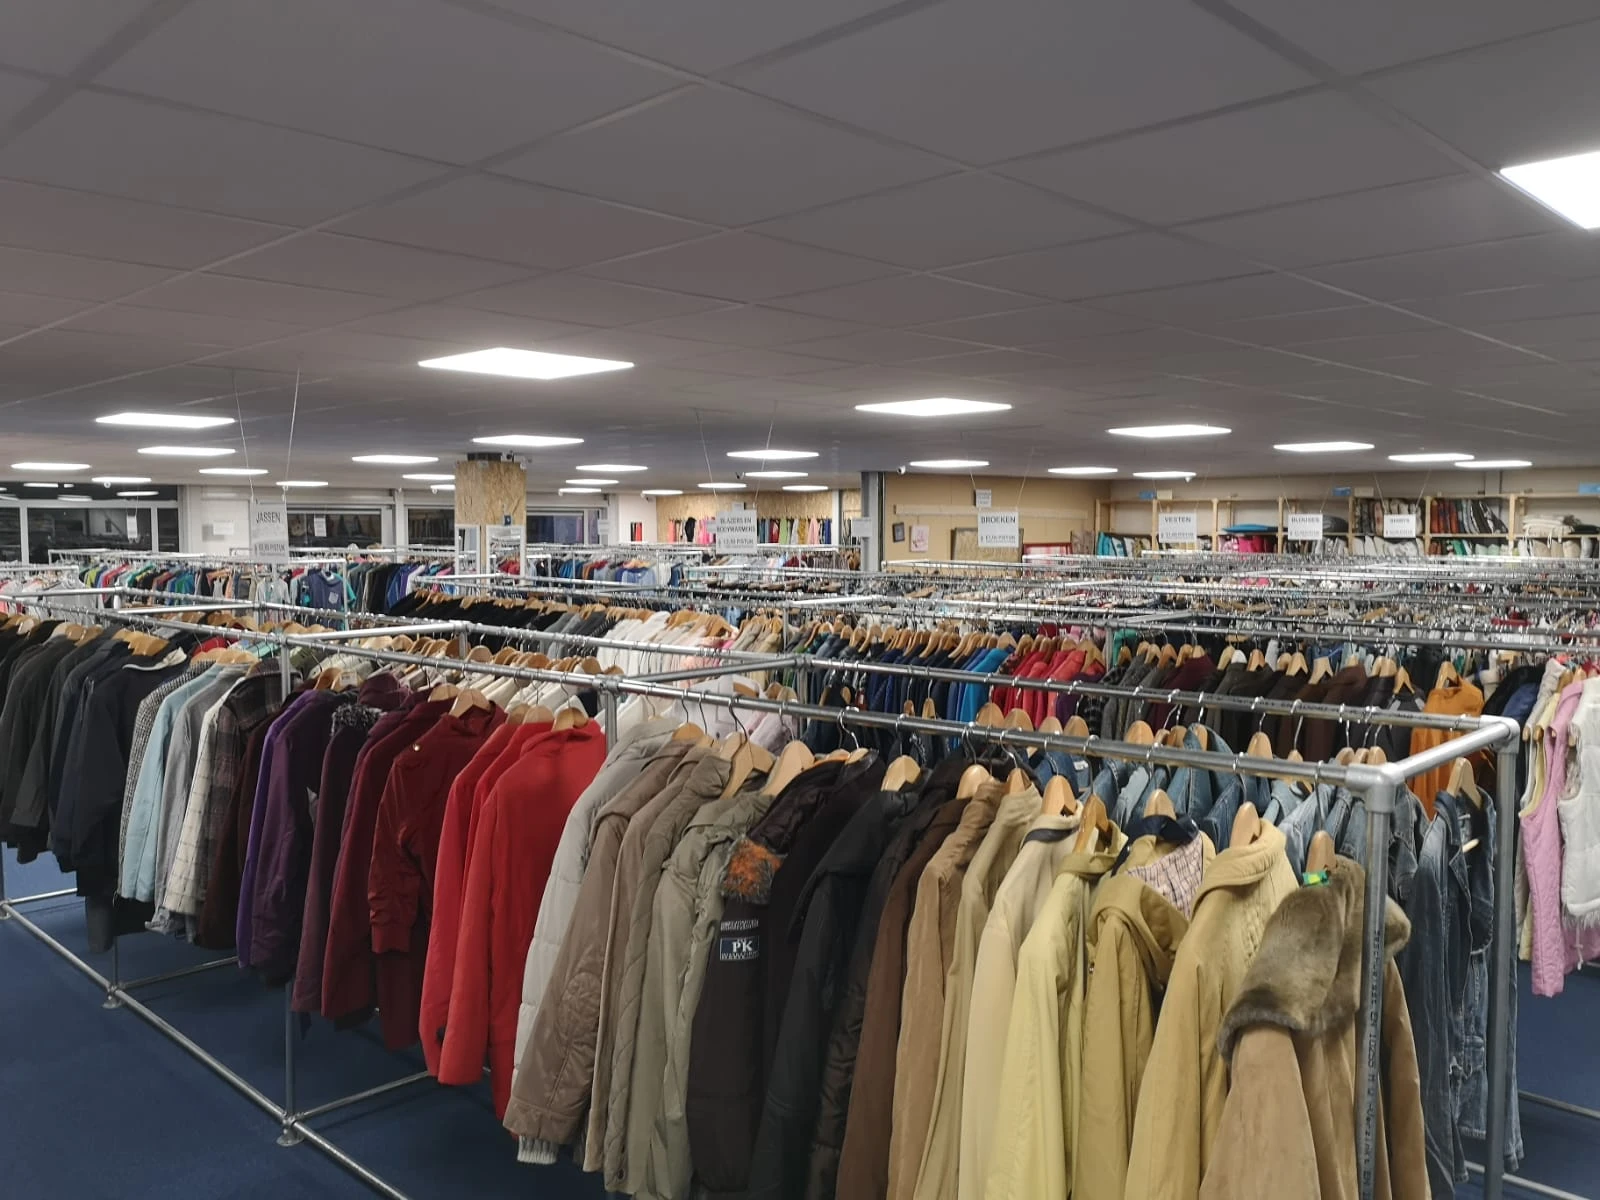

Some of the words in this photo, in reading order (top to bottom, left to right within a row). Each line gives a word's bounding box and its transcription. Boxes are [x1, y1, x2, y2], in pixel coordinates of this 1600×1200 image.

[256, 511, 280, 523] JASSEN
[981, 515, 1015, 524] BROEKEN
[732, 940, 753, 953] PK
